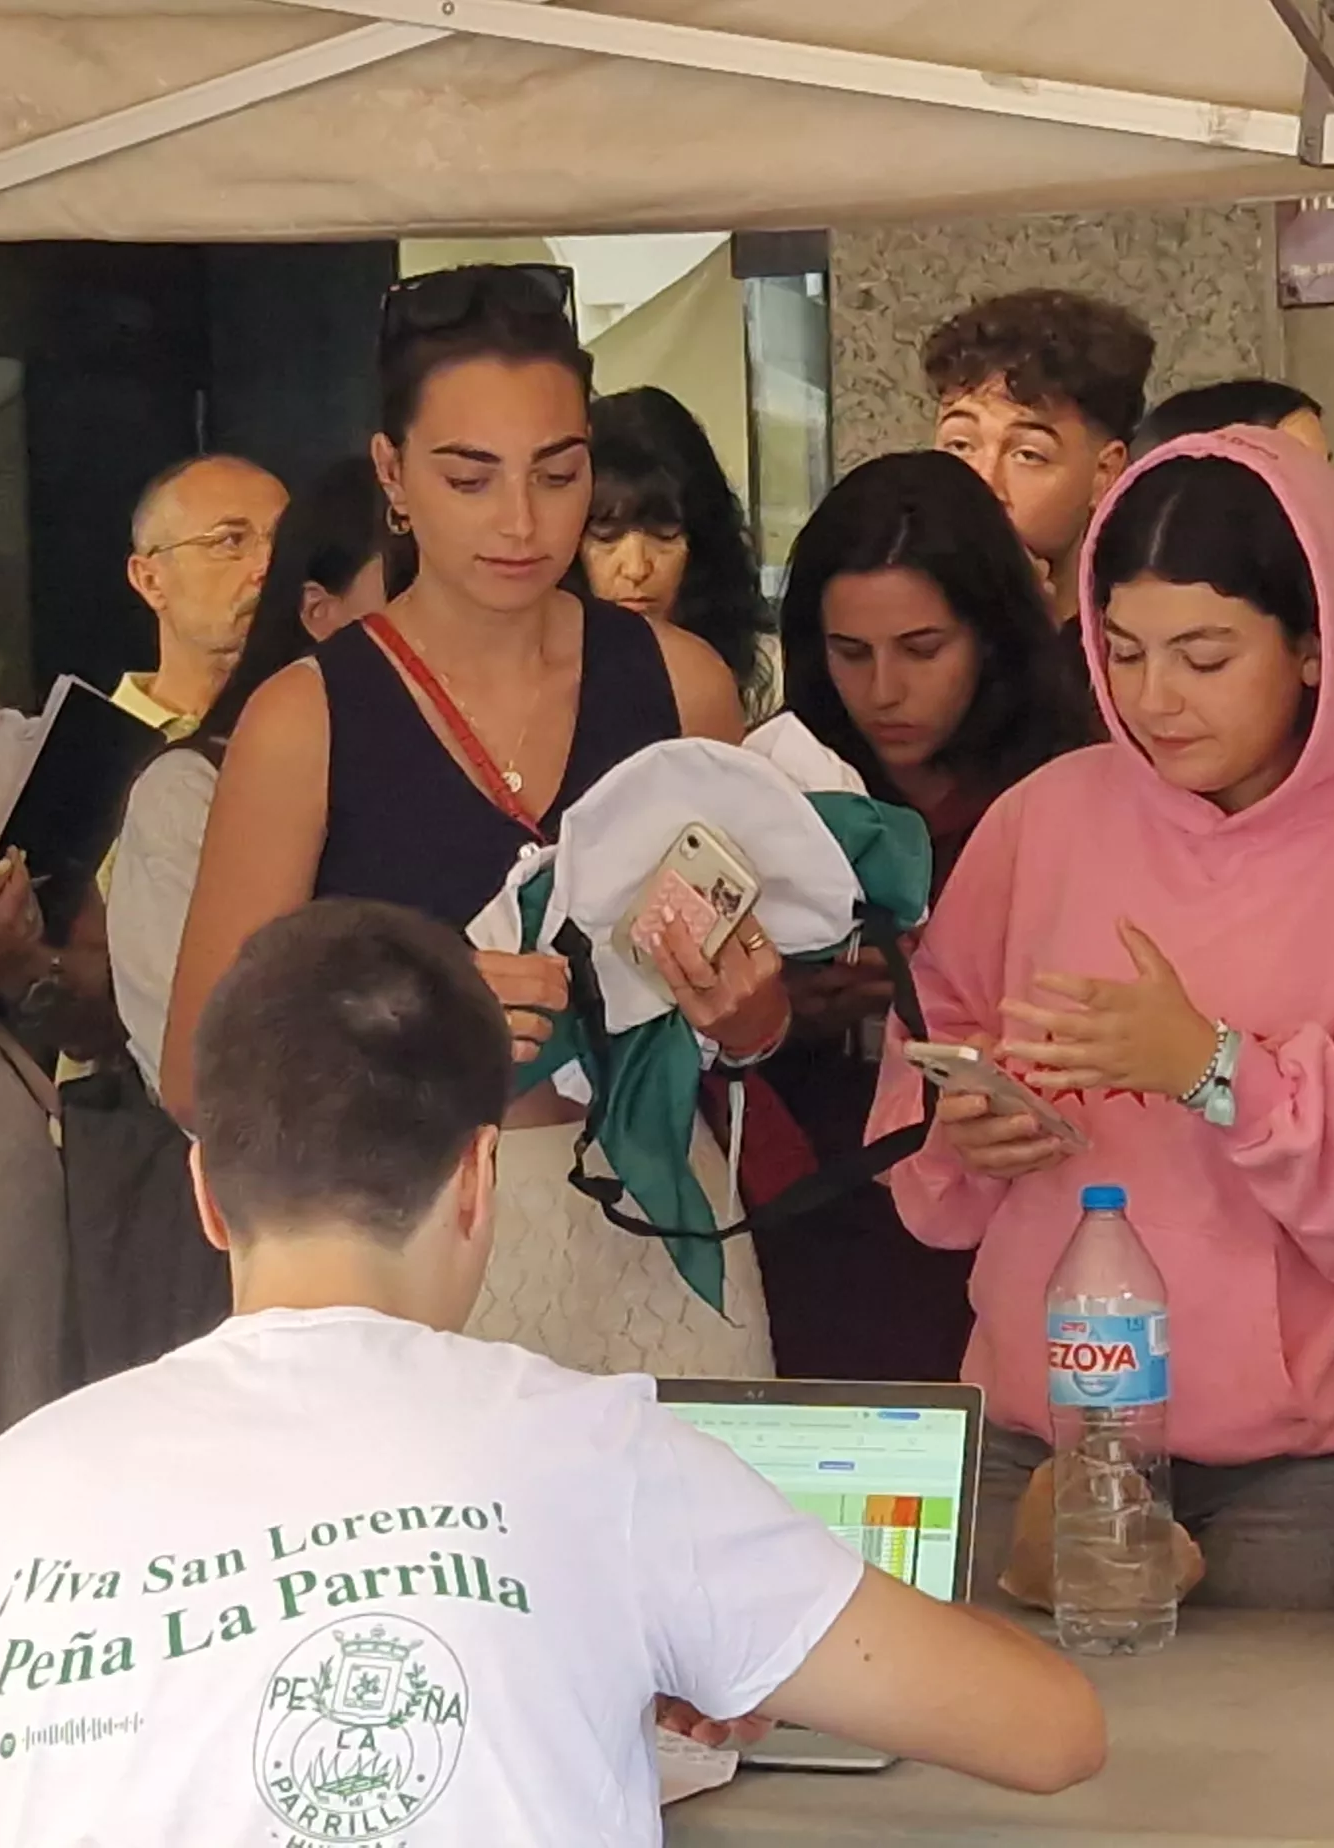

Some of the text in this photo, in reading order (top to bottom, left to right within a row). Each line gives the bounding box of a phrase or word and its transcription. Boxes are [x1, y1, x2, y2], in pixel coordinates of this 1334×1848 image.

[142, 1547, 247, 1597] San
[264, 1502, 510, 1560] Lorenzo!
[162, 1604, 257, 1660] La
[274, 1551, 533, 1621] Parrilla
[337, 1726, 376, 1751] LA
[270, 1776, 420, 1836] PARRILLA
